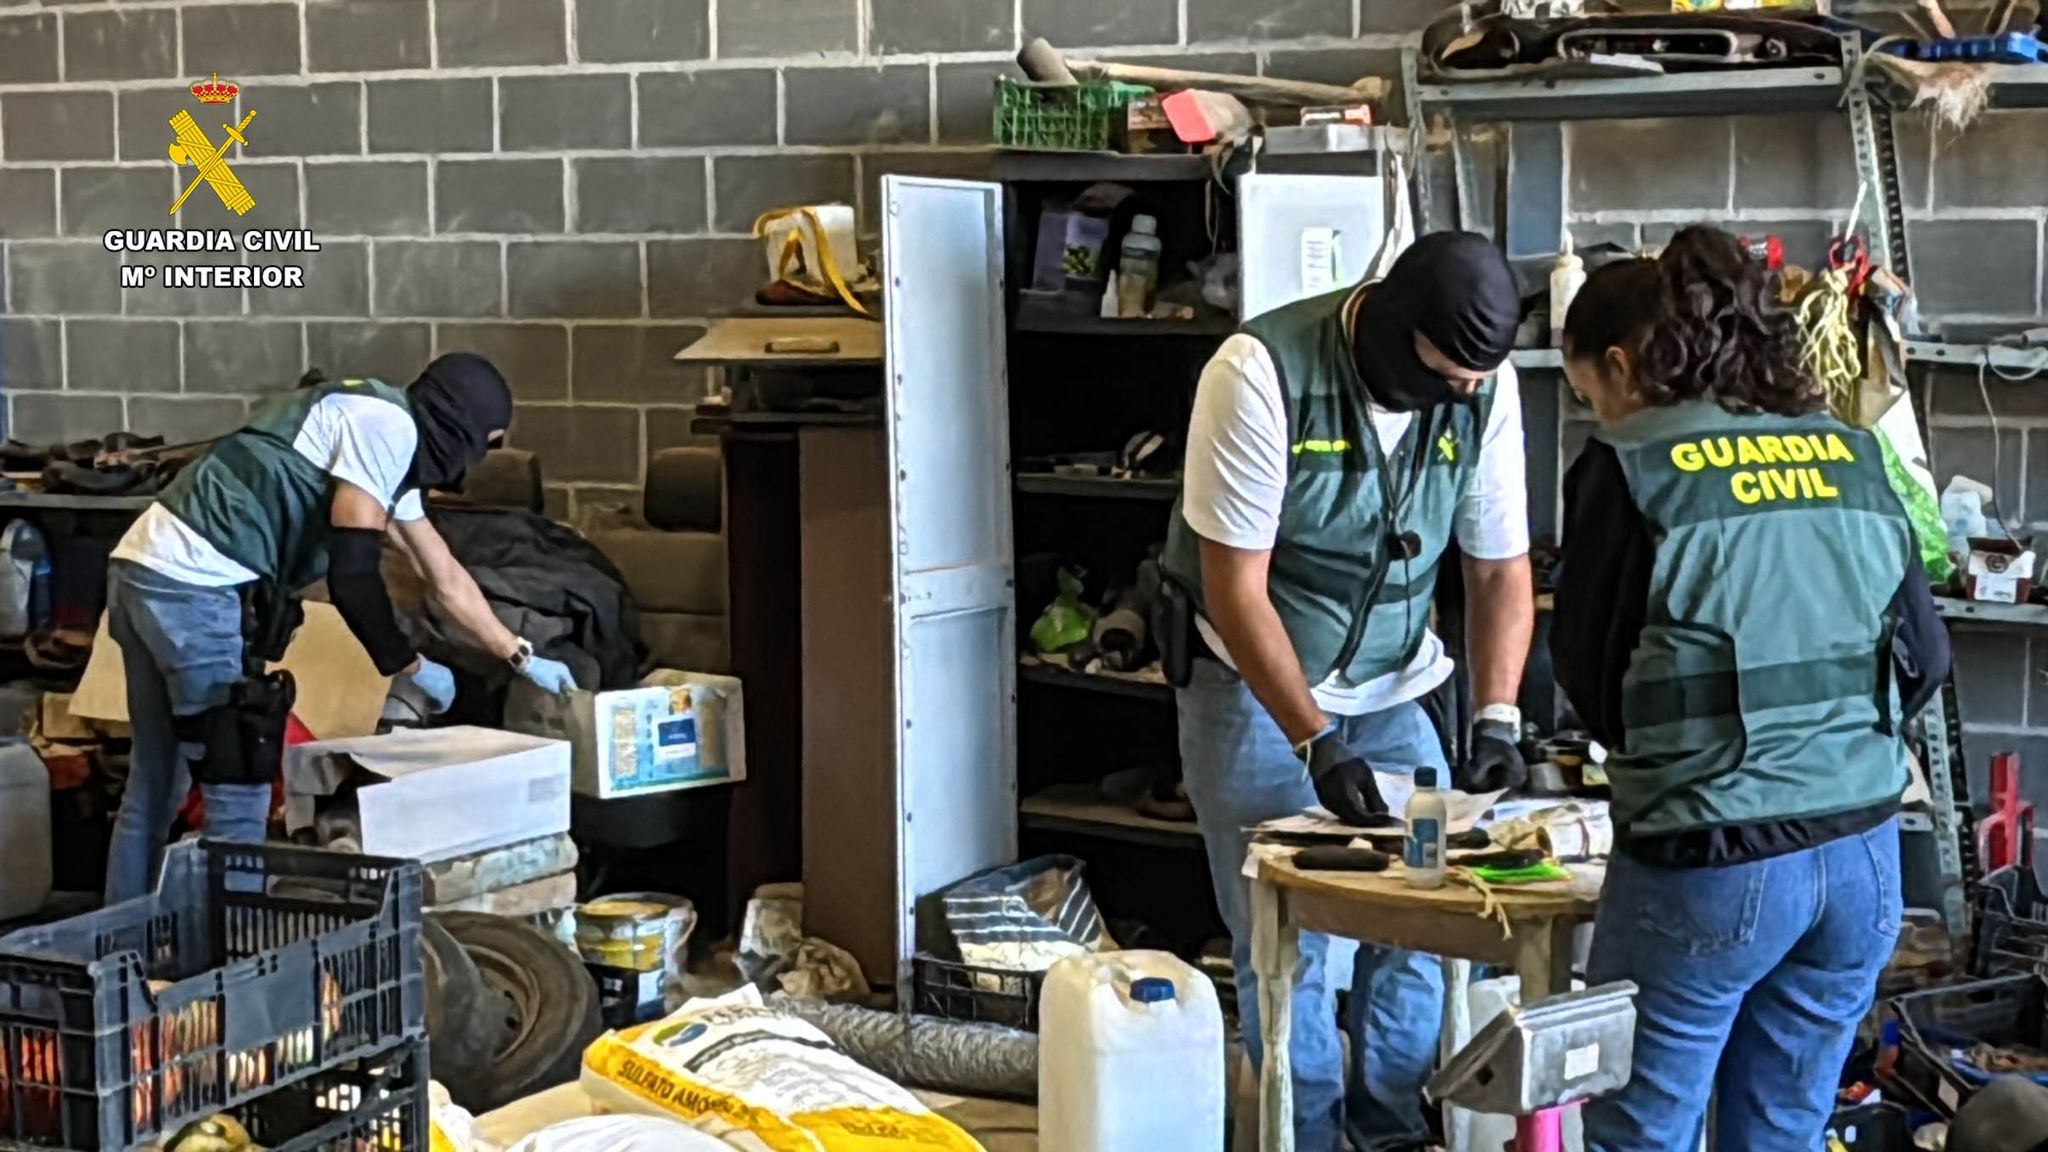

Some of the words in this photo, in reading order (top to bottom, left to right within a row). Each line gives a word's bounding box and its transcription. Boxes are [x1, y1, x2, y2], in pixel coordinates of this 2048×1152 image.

[1671, 433, 1855, 472] GUARDIA
[1730, 468, 1839, 504] CIVIL
[617, 1060, 675, 1098] SULFATO
